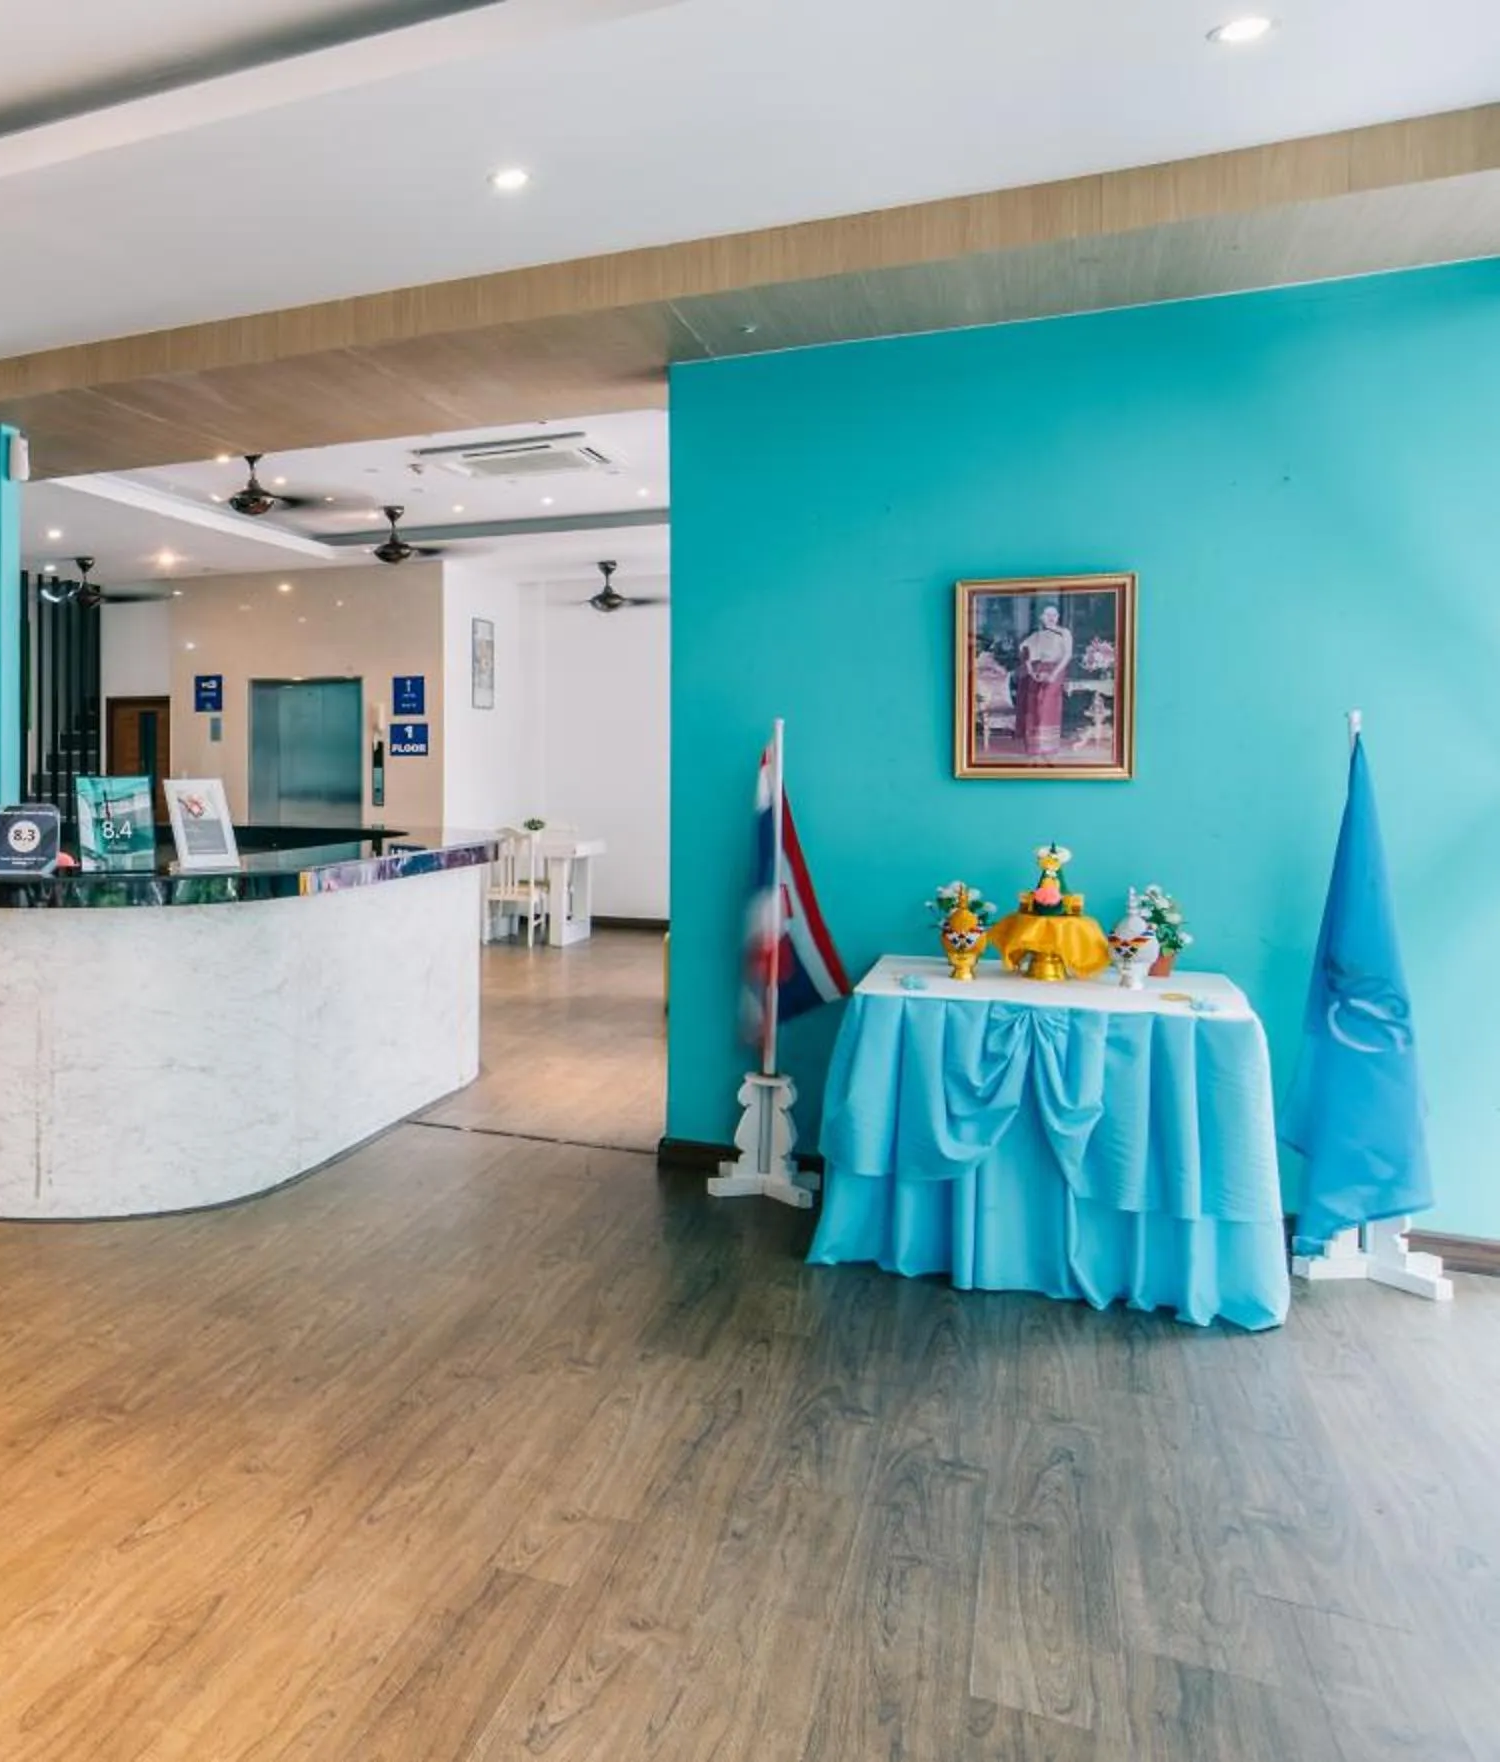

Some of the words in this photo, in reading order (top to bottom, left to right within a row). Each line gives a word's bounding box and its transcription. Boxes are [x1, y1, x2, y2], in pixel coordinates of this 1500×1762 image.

[403, 725, 414, 739] 1
[391, 743, 427, 753] FLOOR
[13, 828, 36, 841] 8.3
[102, 820, 133, 839] 8.4
